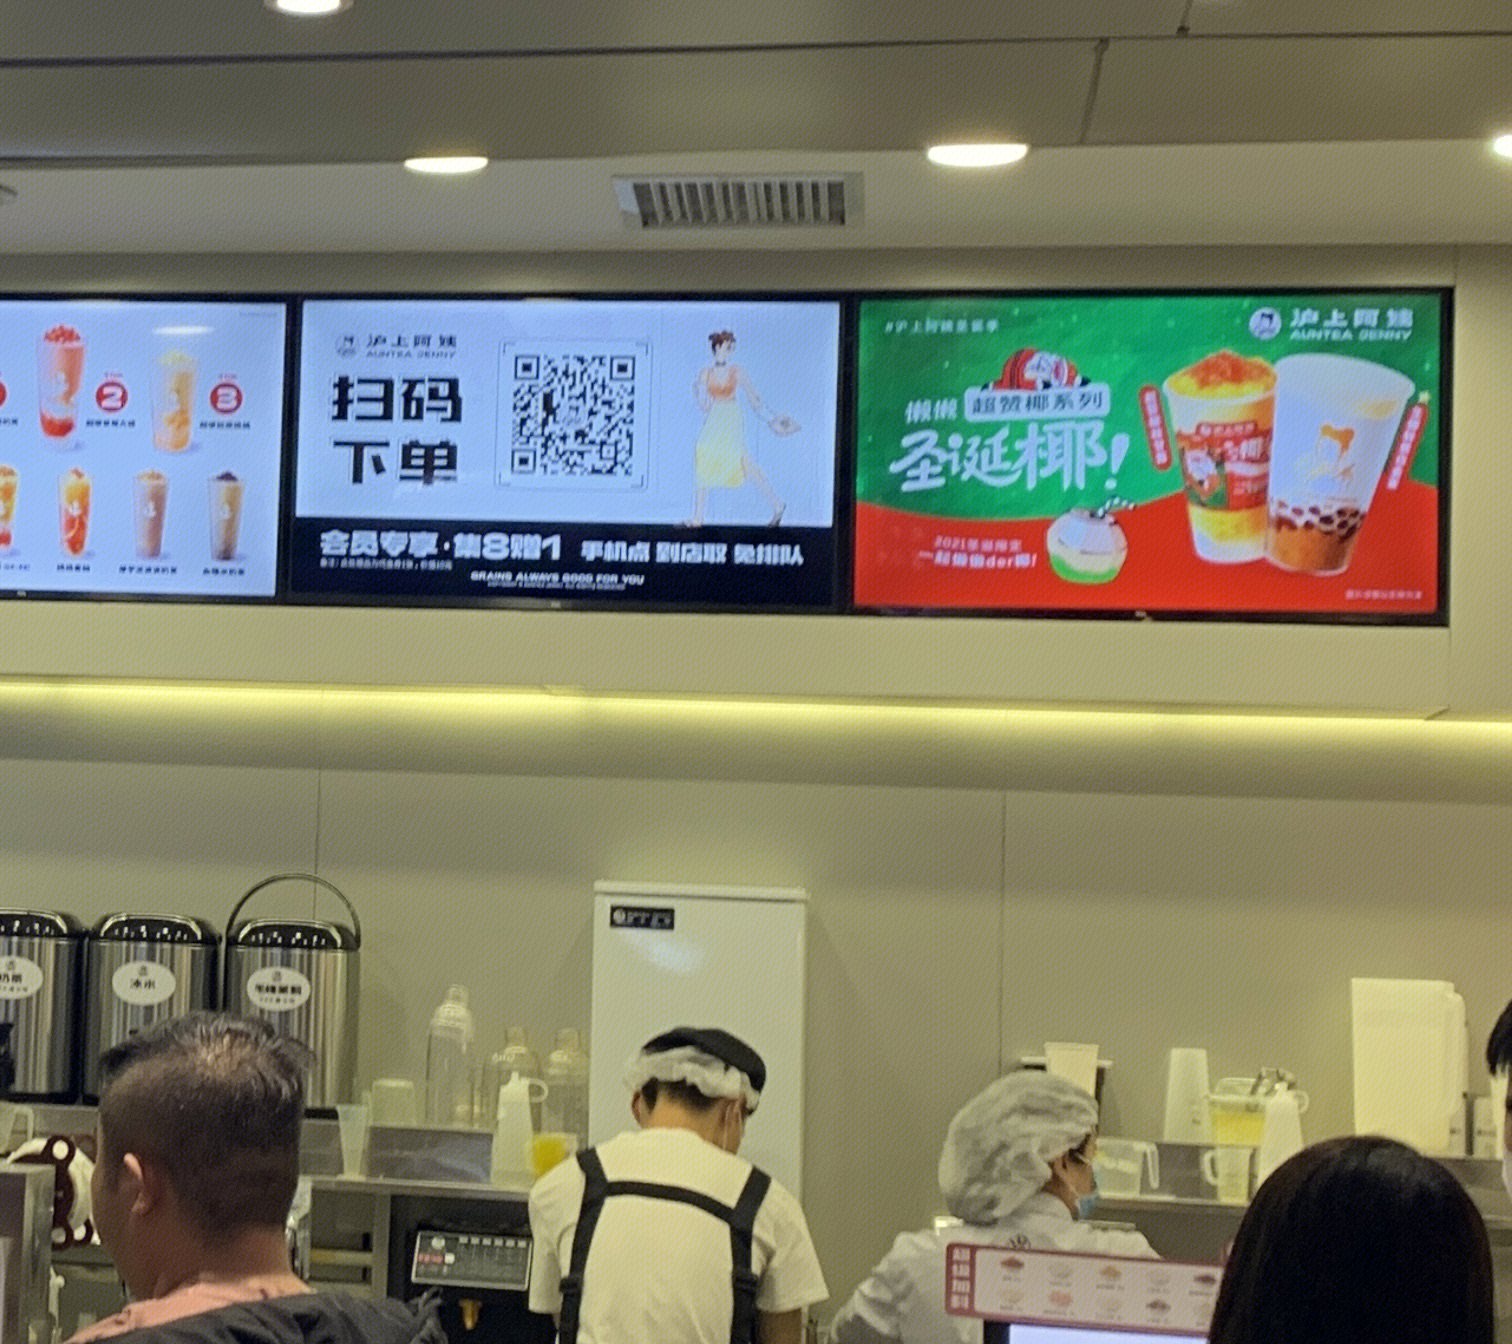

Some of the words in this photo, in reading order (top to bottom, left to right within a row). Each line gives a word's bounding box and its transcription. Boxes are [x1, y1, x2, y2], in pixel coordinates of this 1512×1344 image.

[1290, 307, 1414, 328] 沪上阿姨
[367, 334, 457, 348] 沪上阿姨
[101, 385, 124, 408] 2
[331, 375, 463, 423] 扫码
[333, 439, 458, 485] 下单
